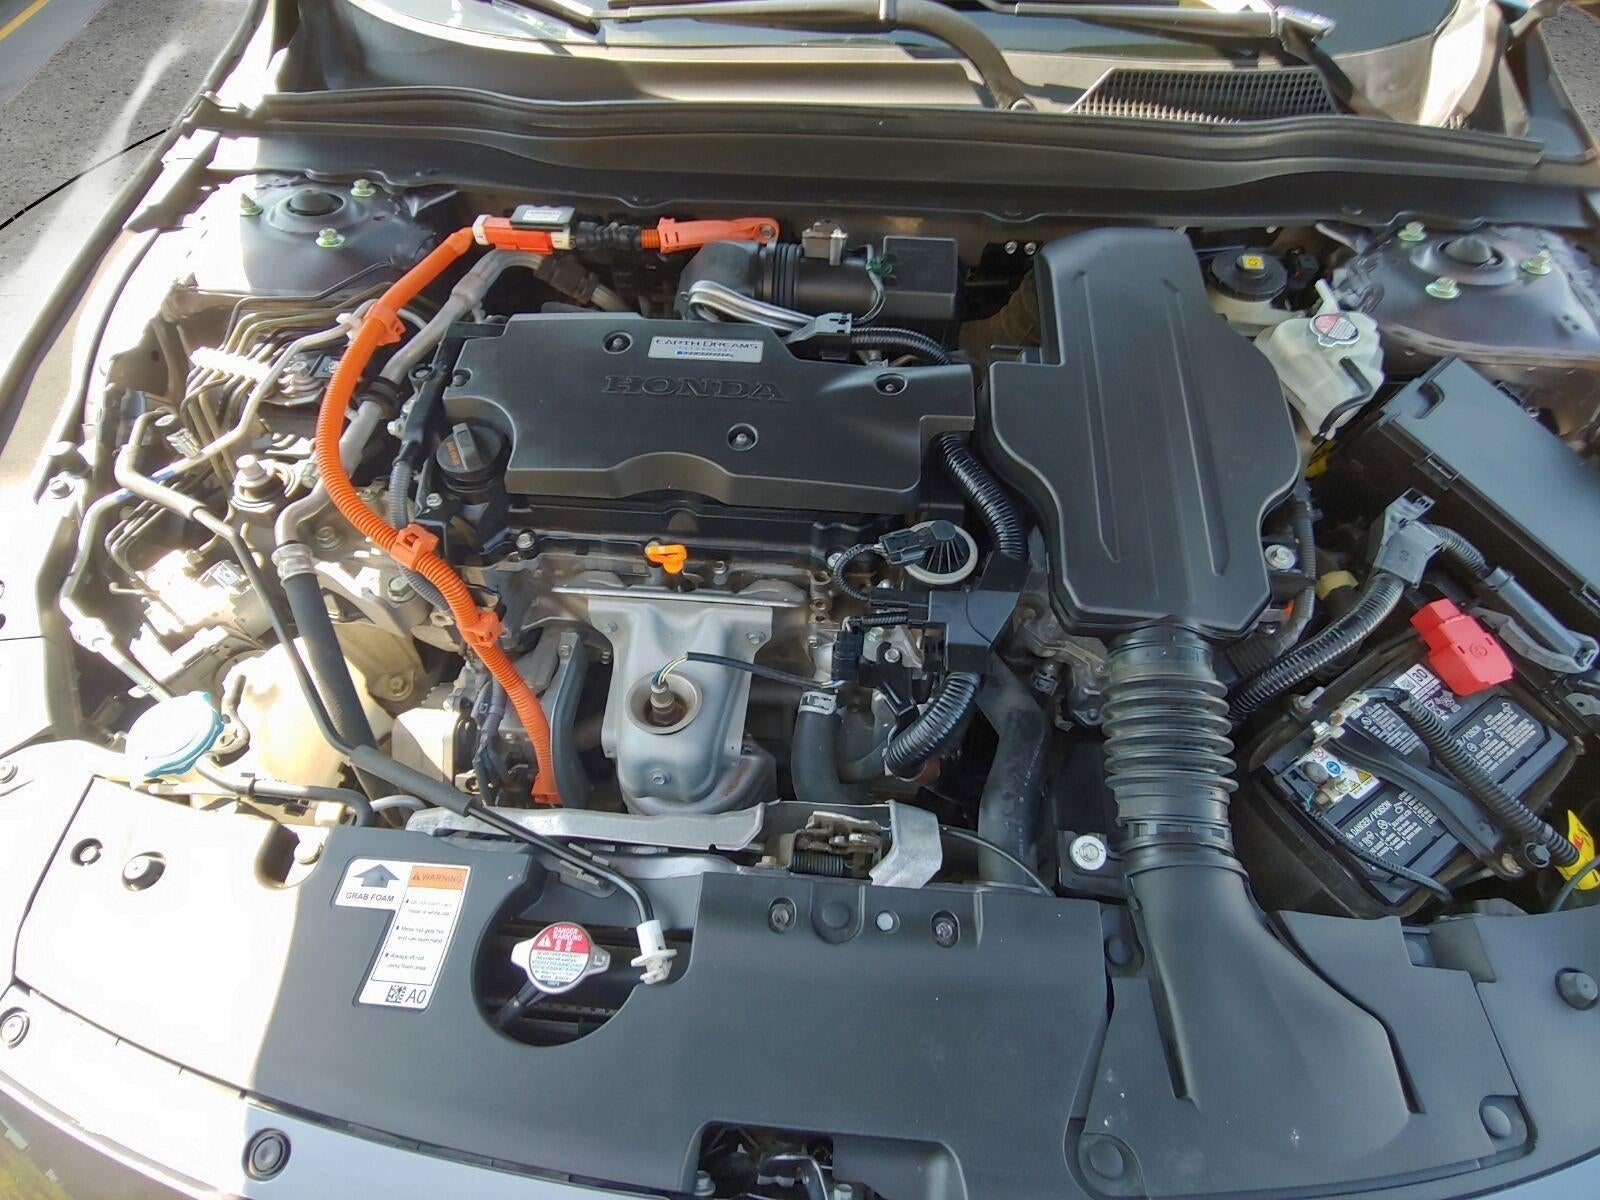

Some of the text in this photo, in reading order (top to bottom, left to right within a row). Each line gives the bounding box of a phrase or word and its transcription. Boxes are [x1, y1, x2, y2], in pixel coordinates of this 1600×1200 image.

[602, 375, 789, 401] HONDA
[422, 872, 463, 883] WARNING
[345, 892, 395, 902] GRAB FOAM
